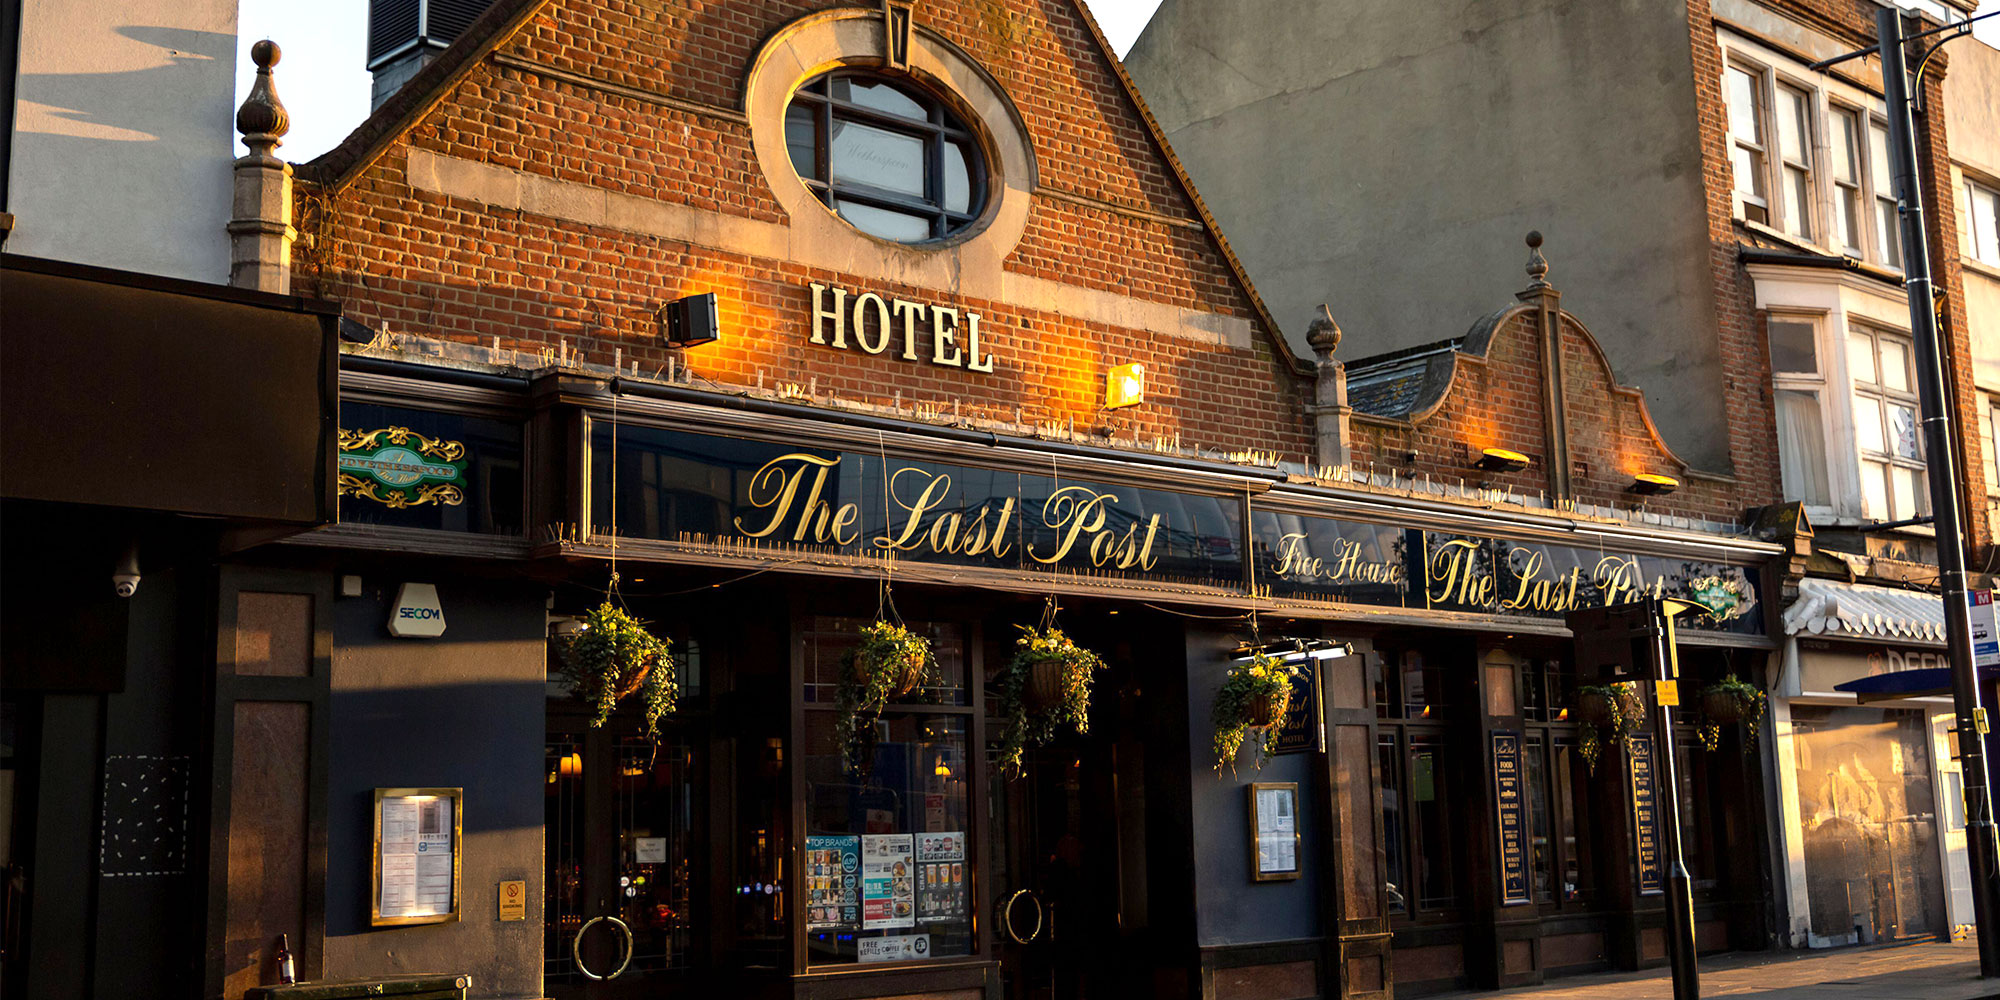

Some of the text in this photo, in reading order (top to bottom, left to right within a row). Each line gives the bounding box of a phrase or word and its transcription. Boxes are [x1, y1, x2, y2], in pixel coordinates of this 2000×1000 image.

[810, 283, 994, 373] HOTEL
[359, 460, 455, 476] WETHERSPOON
[733, 453, 1162, 571] The Last Post
[1271, 532, 1401, 585] Free House
[1429, 539, 1495, 607] The
[1501, 547, 1581, 612] Last
[1978, 594, 1989, 604] M
[400, 607, 440, 620] SECOM
[1282, 735, 1304, 744] HOTEL
[1500, 761, 1514, 769] FOOD
[811, 838, 853, 847] TOP BRANDS
[859, 945, 900, 956] REFILLS COFFEE
[862, 940, 878, 949] FREE
